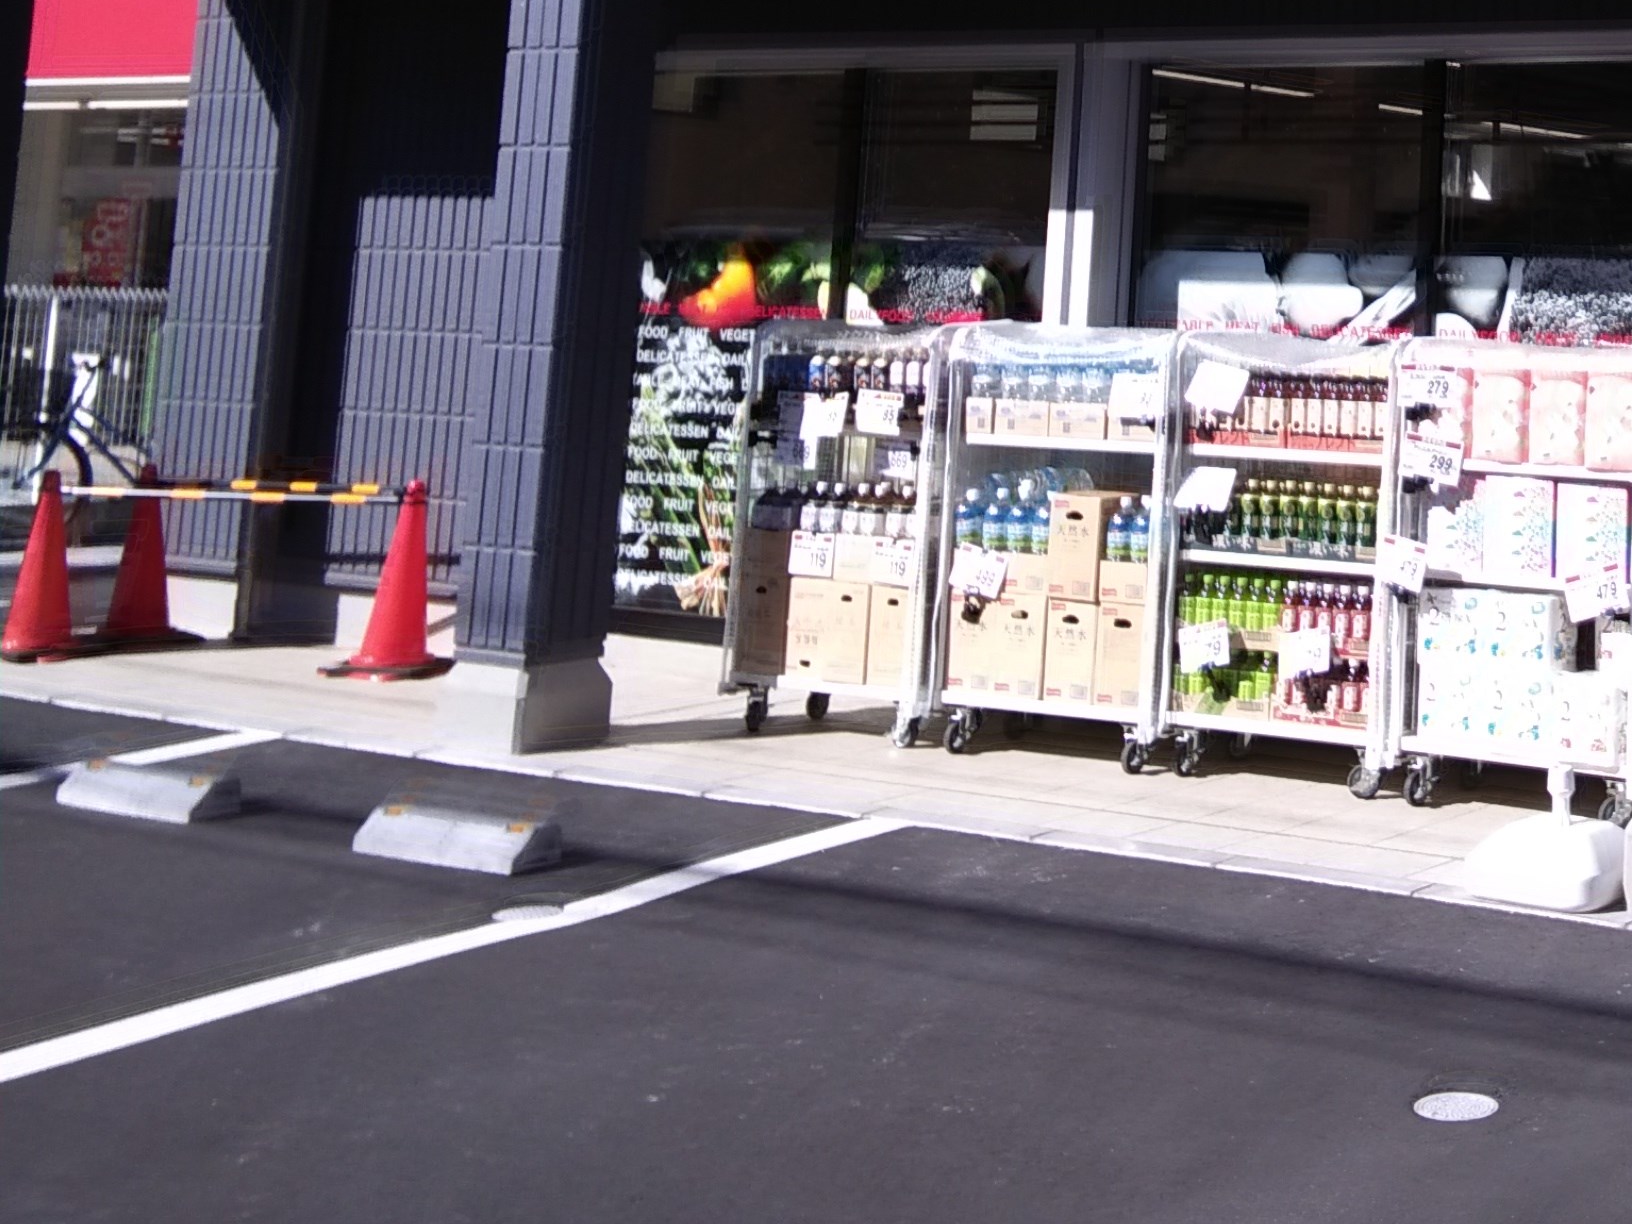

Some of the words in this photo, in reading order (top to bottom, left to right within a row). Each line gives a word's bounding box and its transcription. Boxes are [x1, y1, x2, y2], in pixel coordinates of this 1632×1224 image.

[637, 326, 669, 340] FOOD
[678, 326, 710, 340] FRUIT
[1427, 380, 1450, 396] 279
[1429, 453, 1454, 472] 299
[663, 497, 695, 512] FRUIT
[618, 544, 649, 559] FOOD
[658, 547, 691, 561] FRUIT
[1596, 581, 1618, 600] 479
